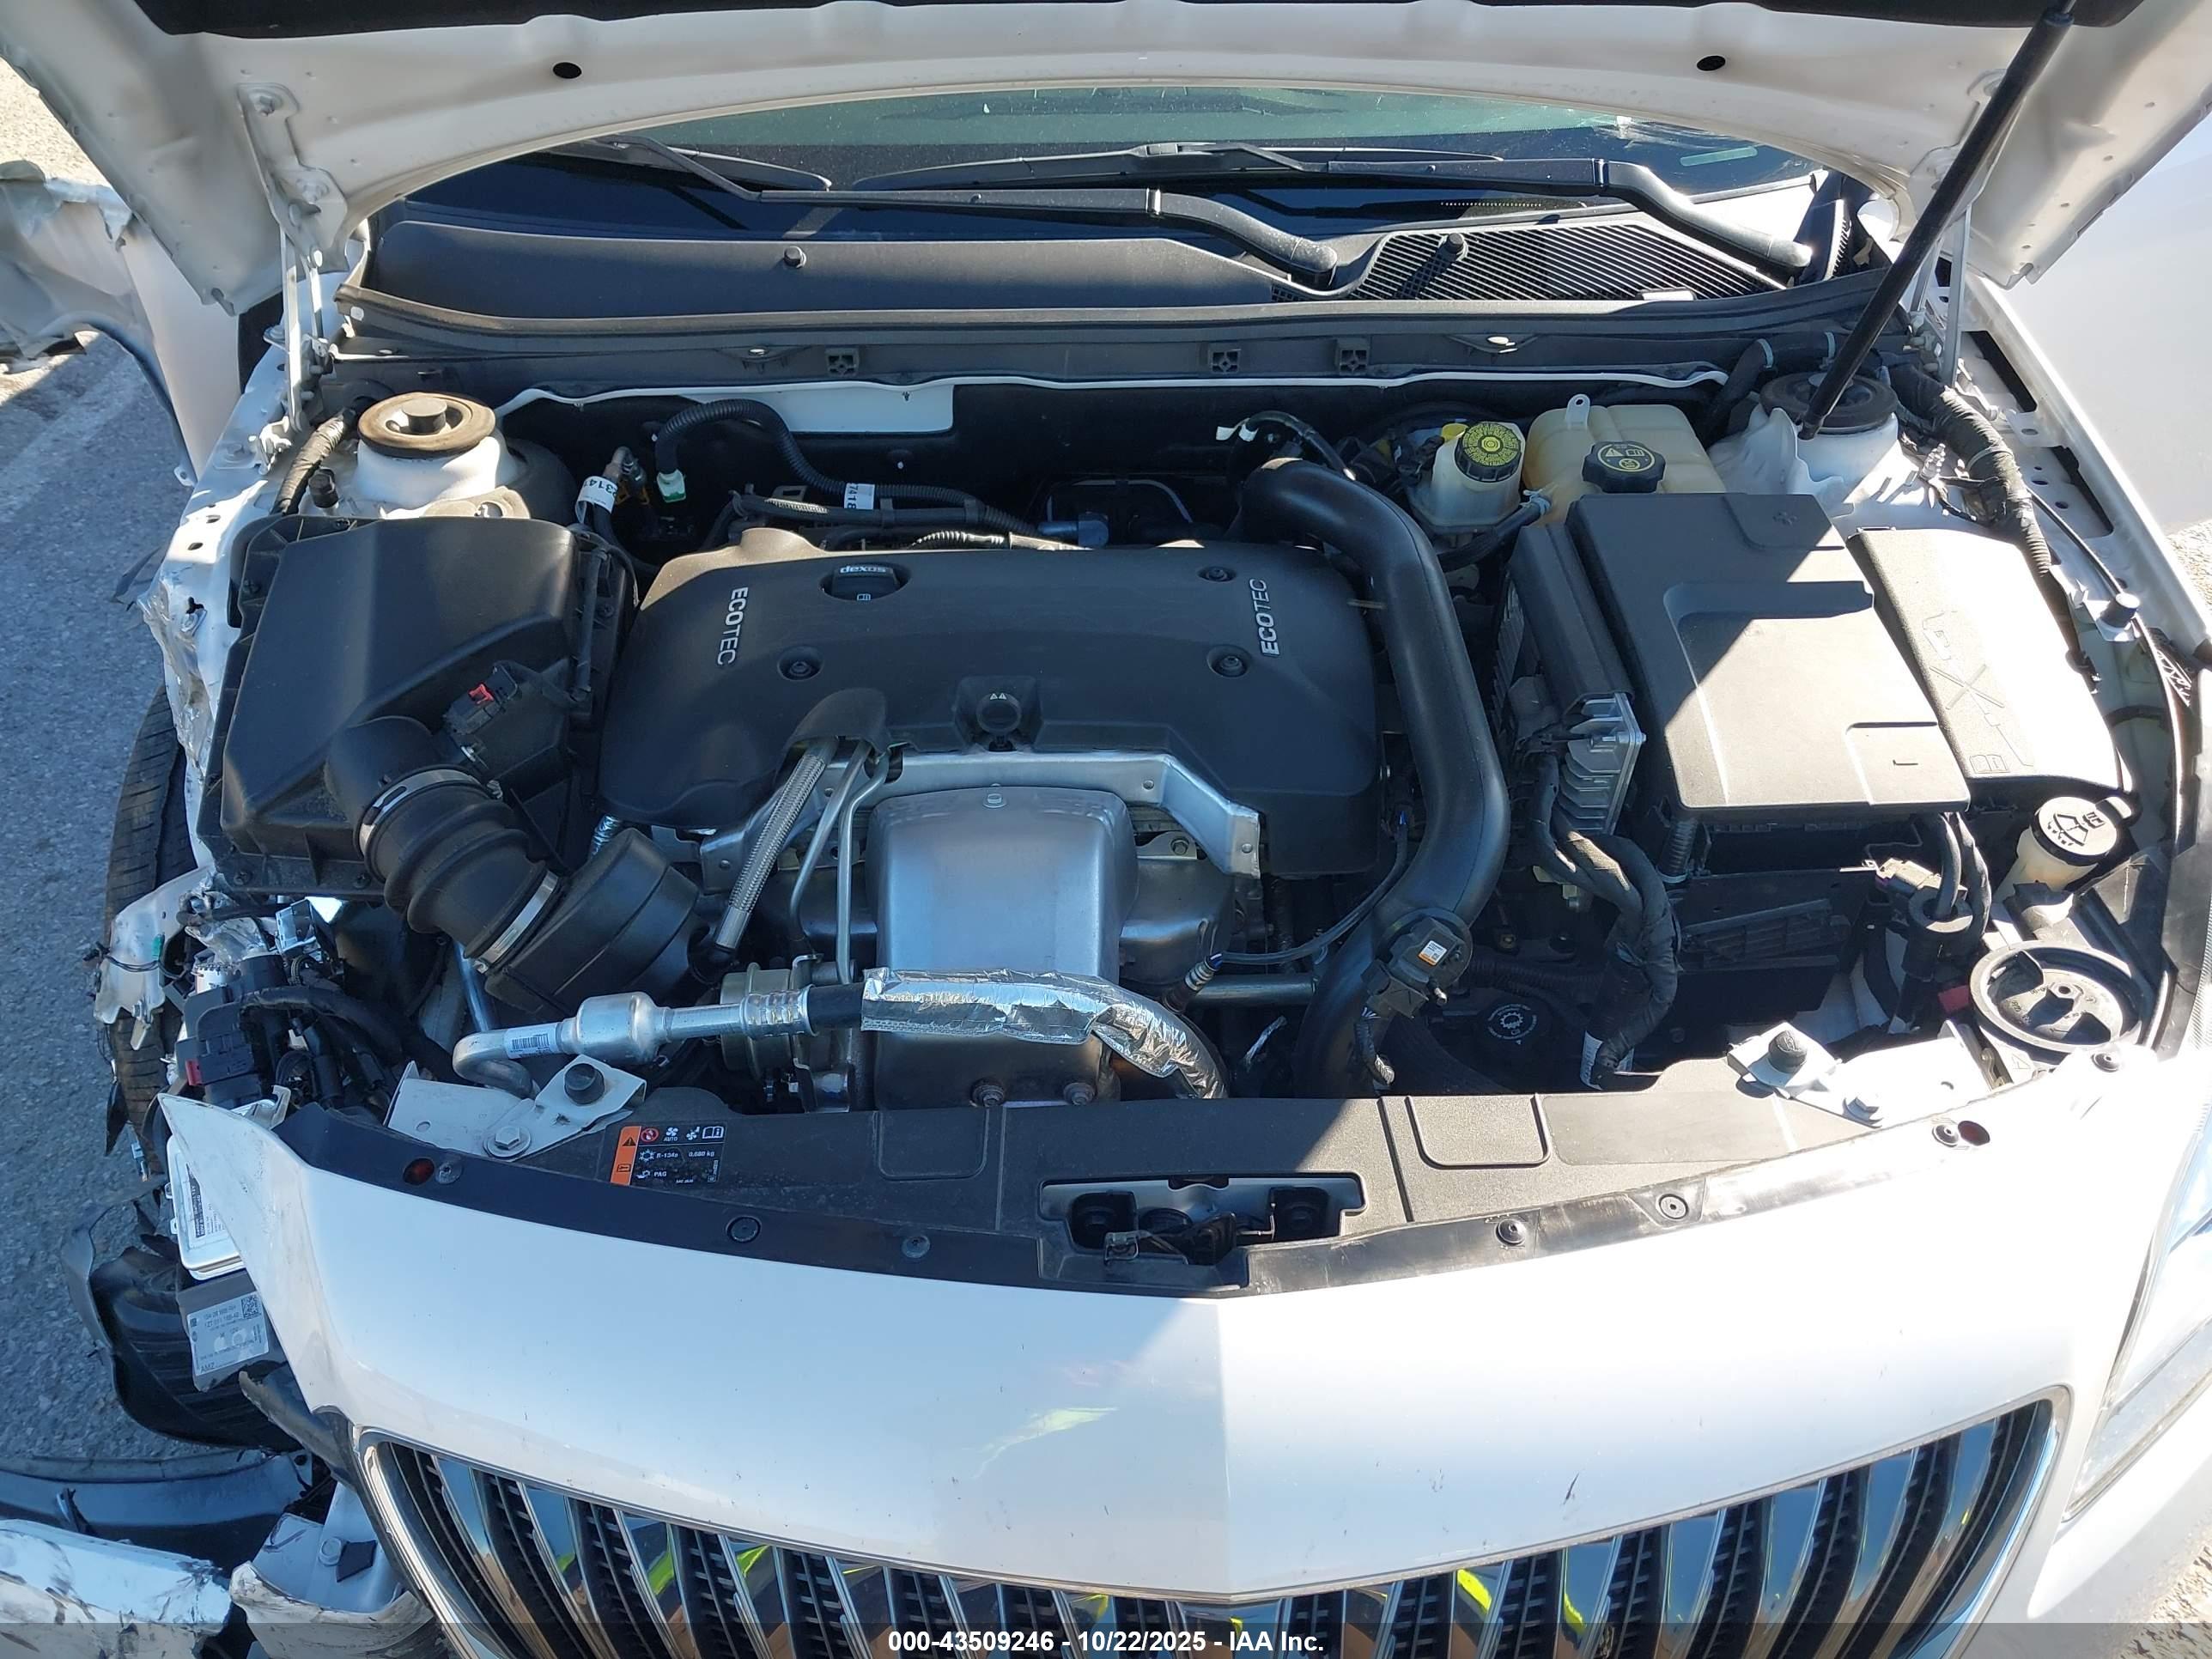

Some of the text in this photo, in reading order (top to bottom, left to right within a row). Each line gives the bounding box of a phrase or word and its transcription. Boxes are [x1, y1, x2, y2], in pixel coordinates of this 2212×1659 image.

[839, 564, 887, 574] dexos
[716, 586, 749, 665] ECOTEC
[1249, 578, 1280, 655] ECOTEC
